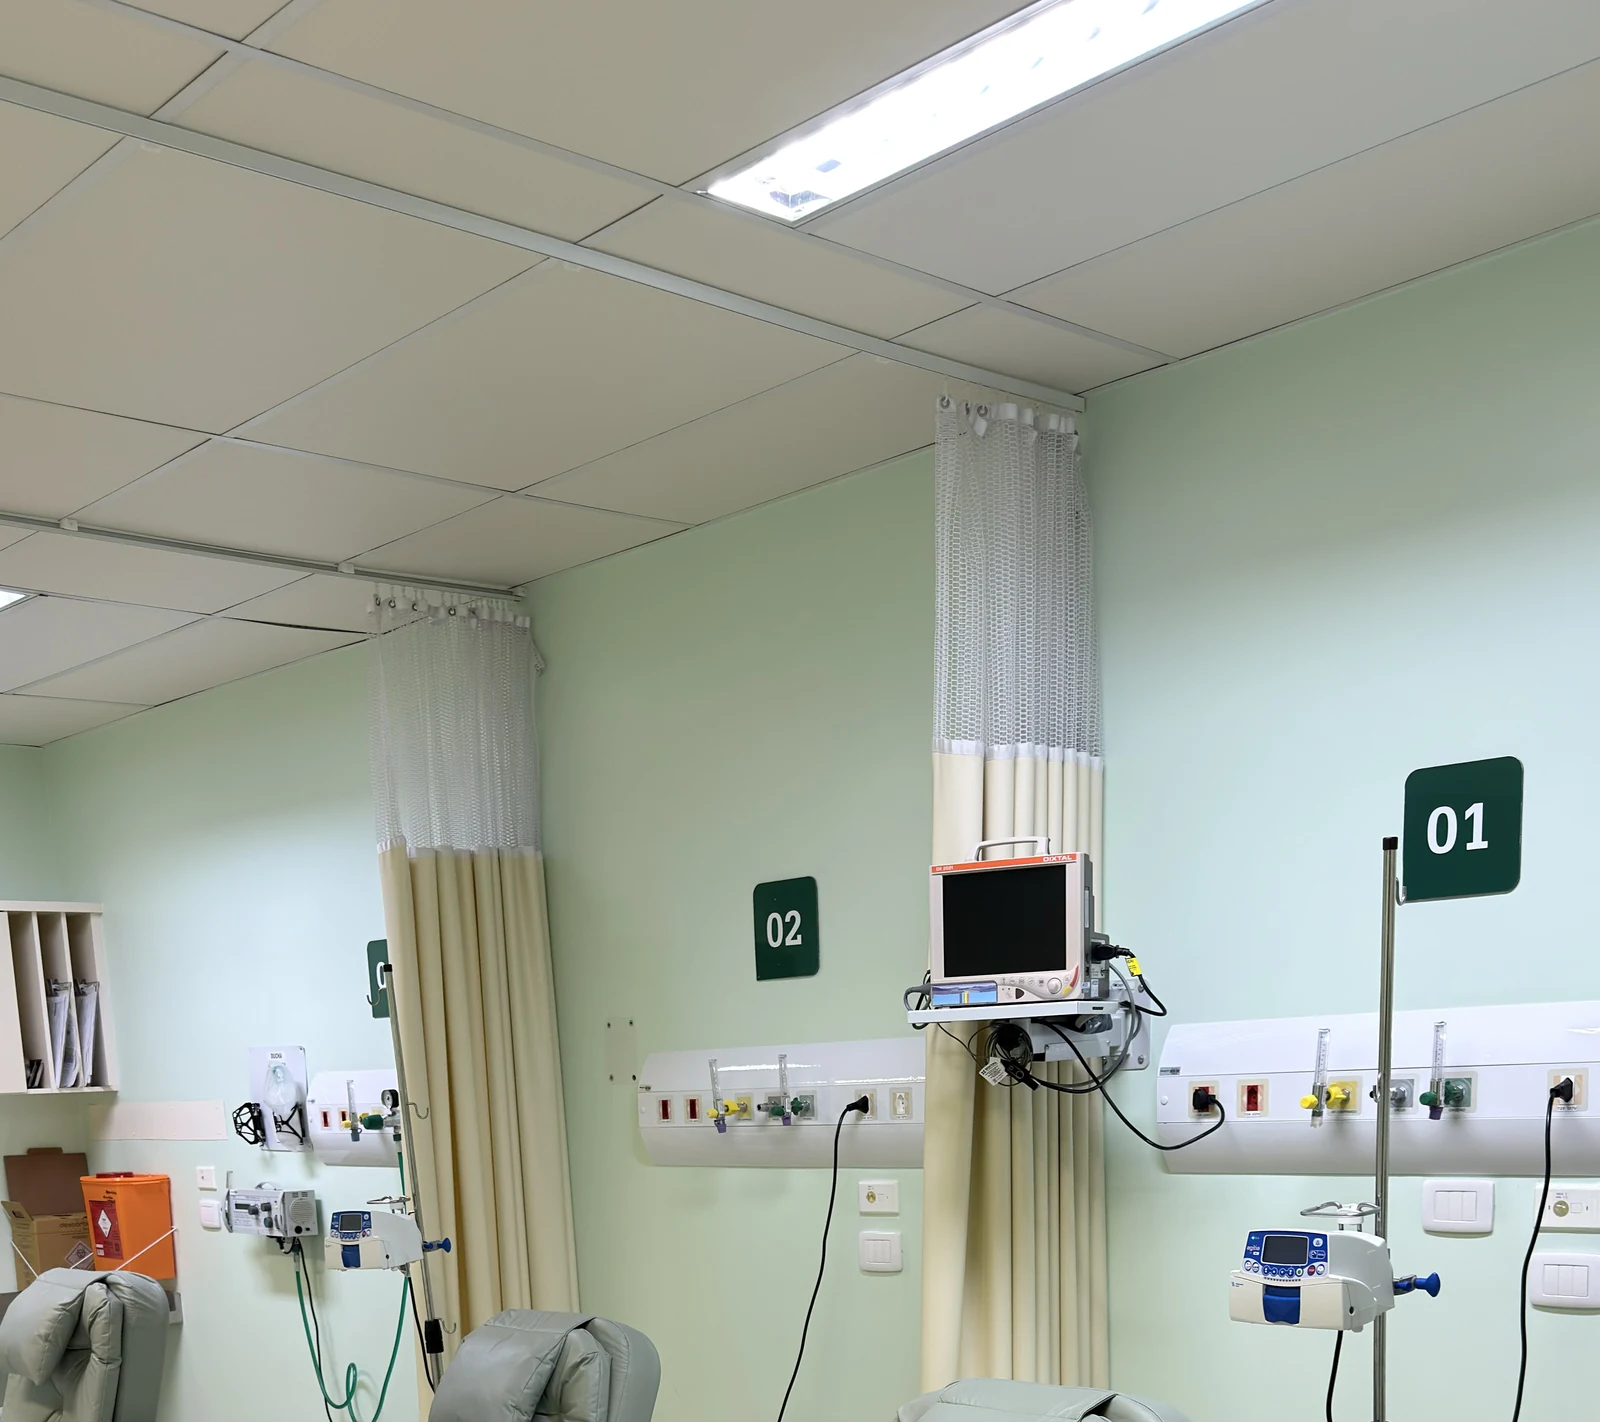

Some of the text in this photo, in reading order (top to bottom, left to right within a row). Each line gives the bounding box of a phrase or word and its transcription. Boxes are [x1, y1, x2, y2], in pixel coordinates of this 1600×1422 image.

[1427, 802, 1489, 855] 01
[766, 910, 802, 948] 02
[376, 961, 387, 989] 0
